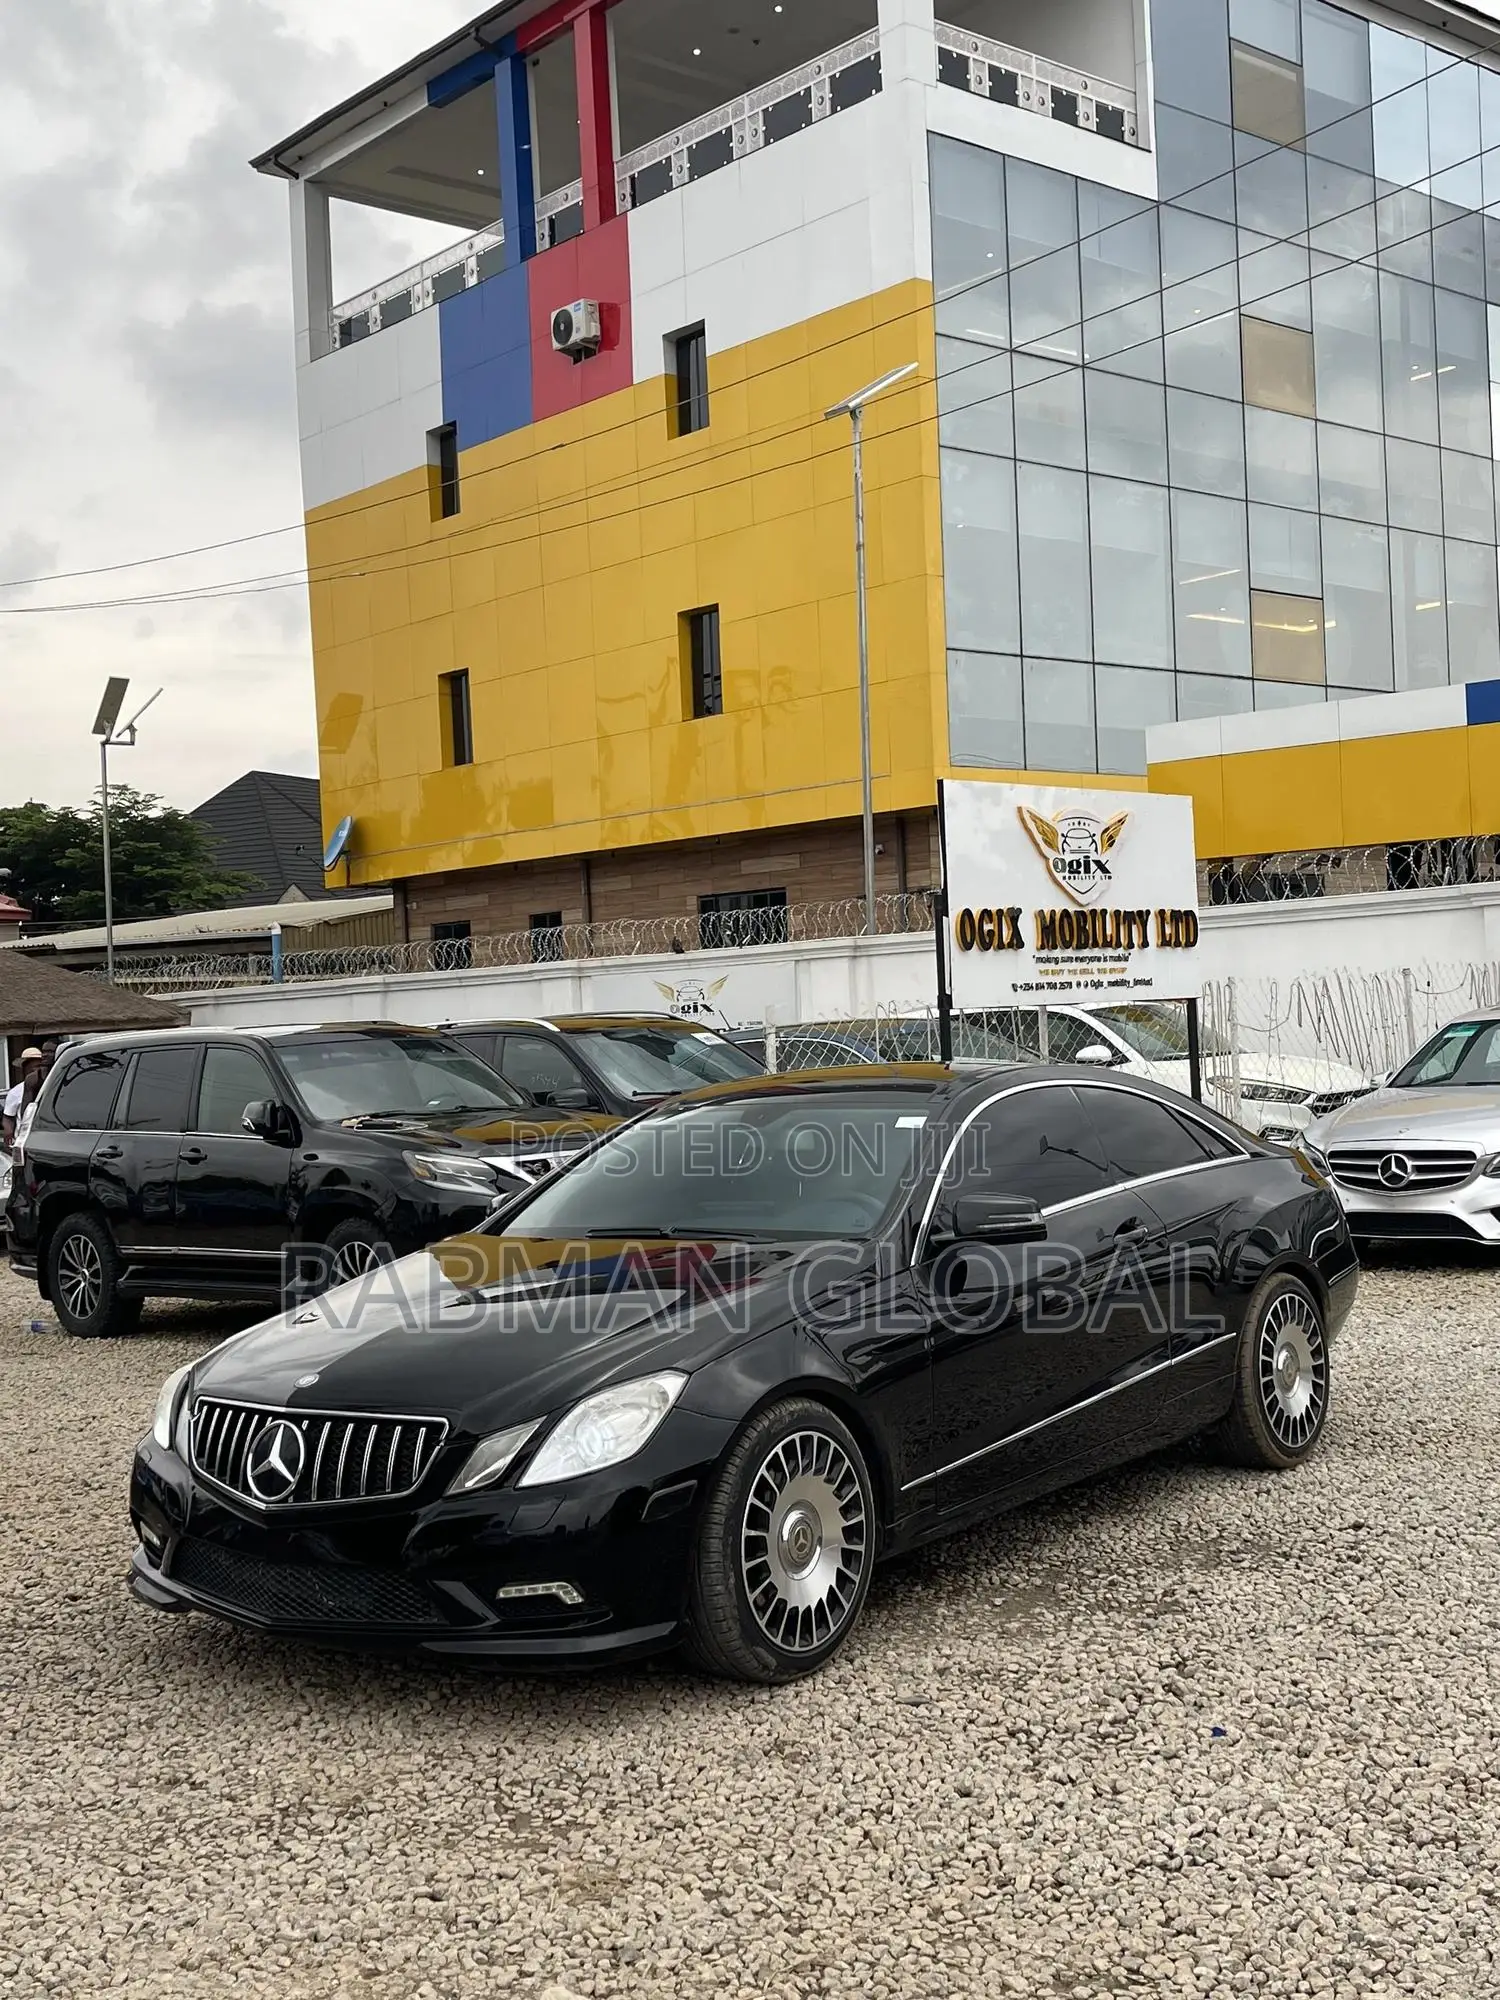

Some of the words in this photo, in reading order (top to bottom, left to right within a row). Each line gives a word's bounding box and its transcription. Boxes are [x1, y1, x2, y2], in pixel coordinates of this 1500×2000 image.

[1053, 855, 1112, 875] Ogix
[955, 907, 1025, 951] OGIX
[1034, 908, 1151, 951] MOBILITY
[1155, 908, 1199, 949] LTD
[1075, 955, 1101, 964] everyone
[1102, 954, 1108, 963] is
